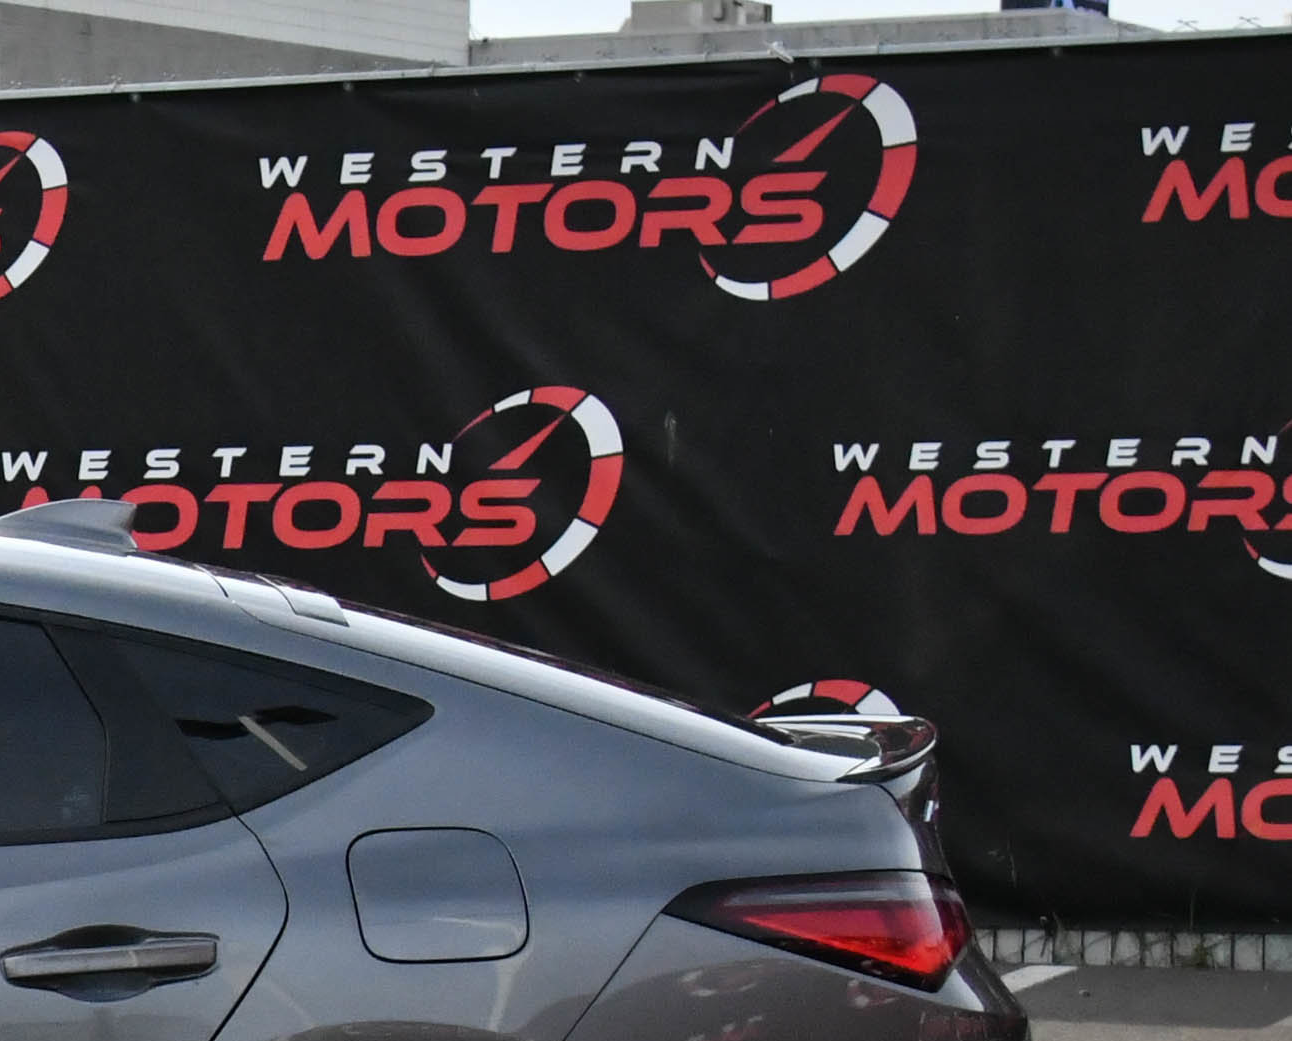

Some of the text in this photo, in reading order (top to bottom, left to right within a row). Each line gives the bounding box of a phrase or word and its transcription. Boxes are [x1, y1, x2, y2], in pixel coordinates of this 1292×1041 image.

[259, 137, 734, 189] WESTERN
[1141, 122, 1292, 156] WE
[262, 171, 827, 262] MOTORS
[1, 443, 453, 482] WESTERN
[833, 435, 1278, 472] WESTERN
[21, 478, 541, 552] OTORS
[834, 469, 1292, 537] MOTOR
